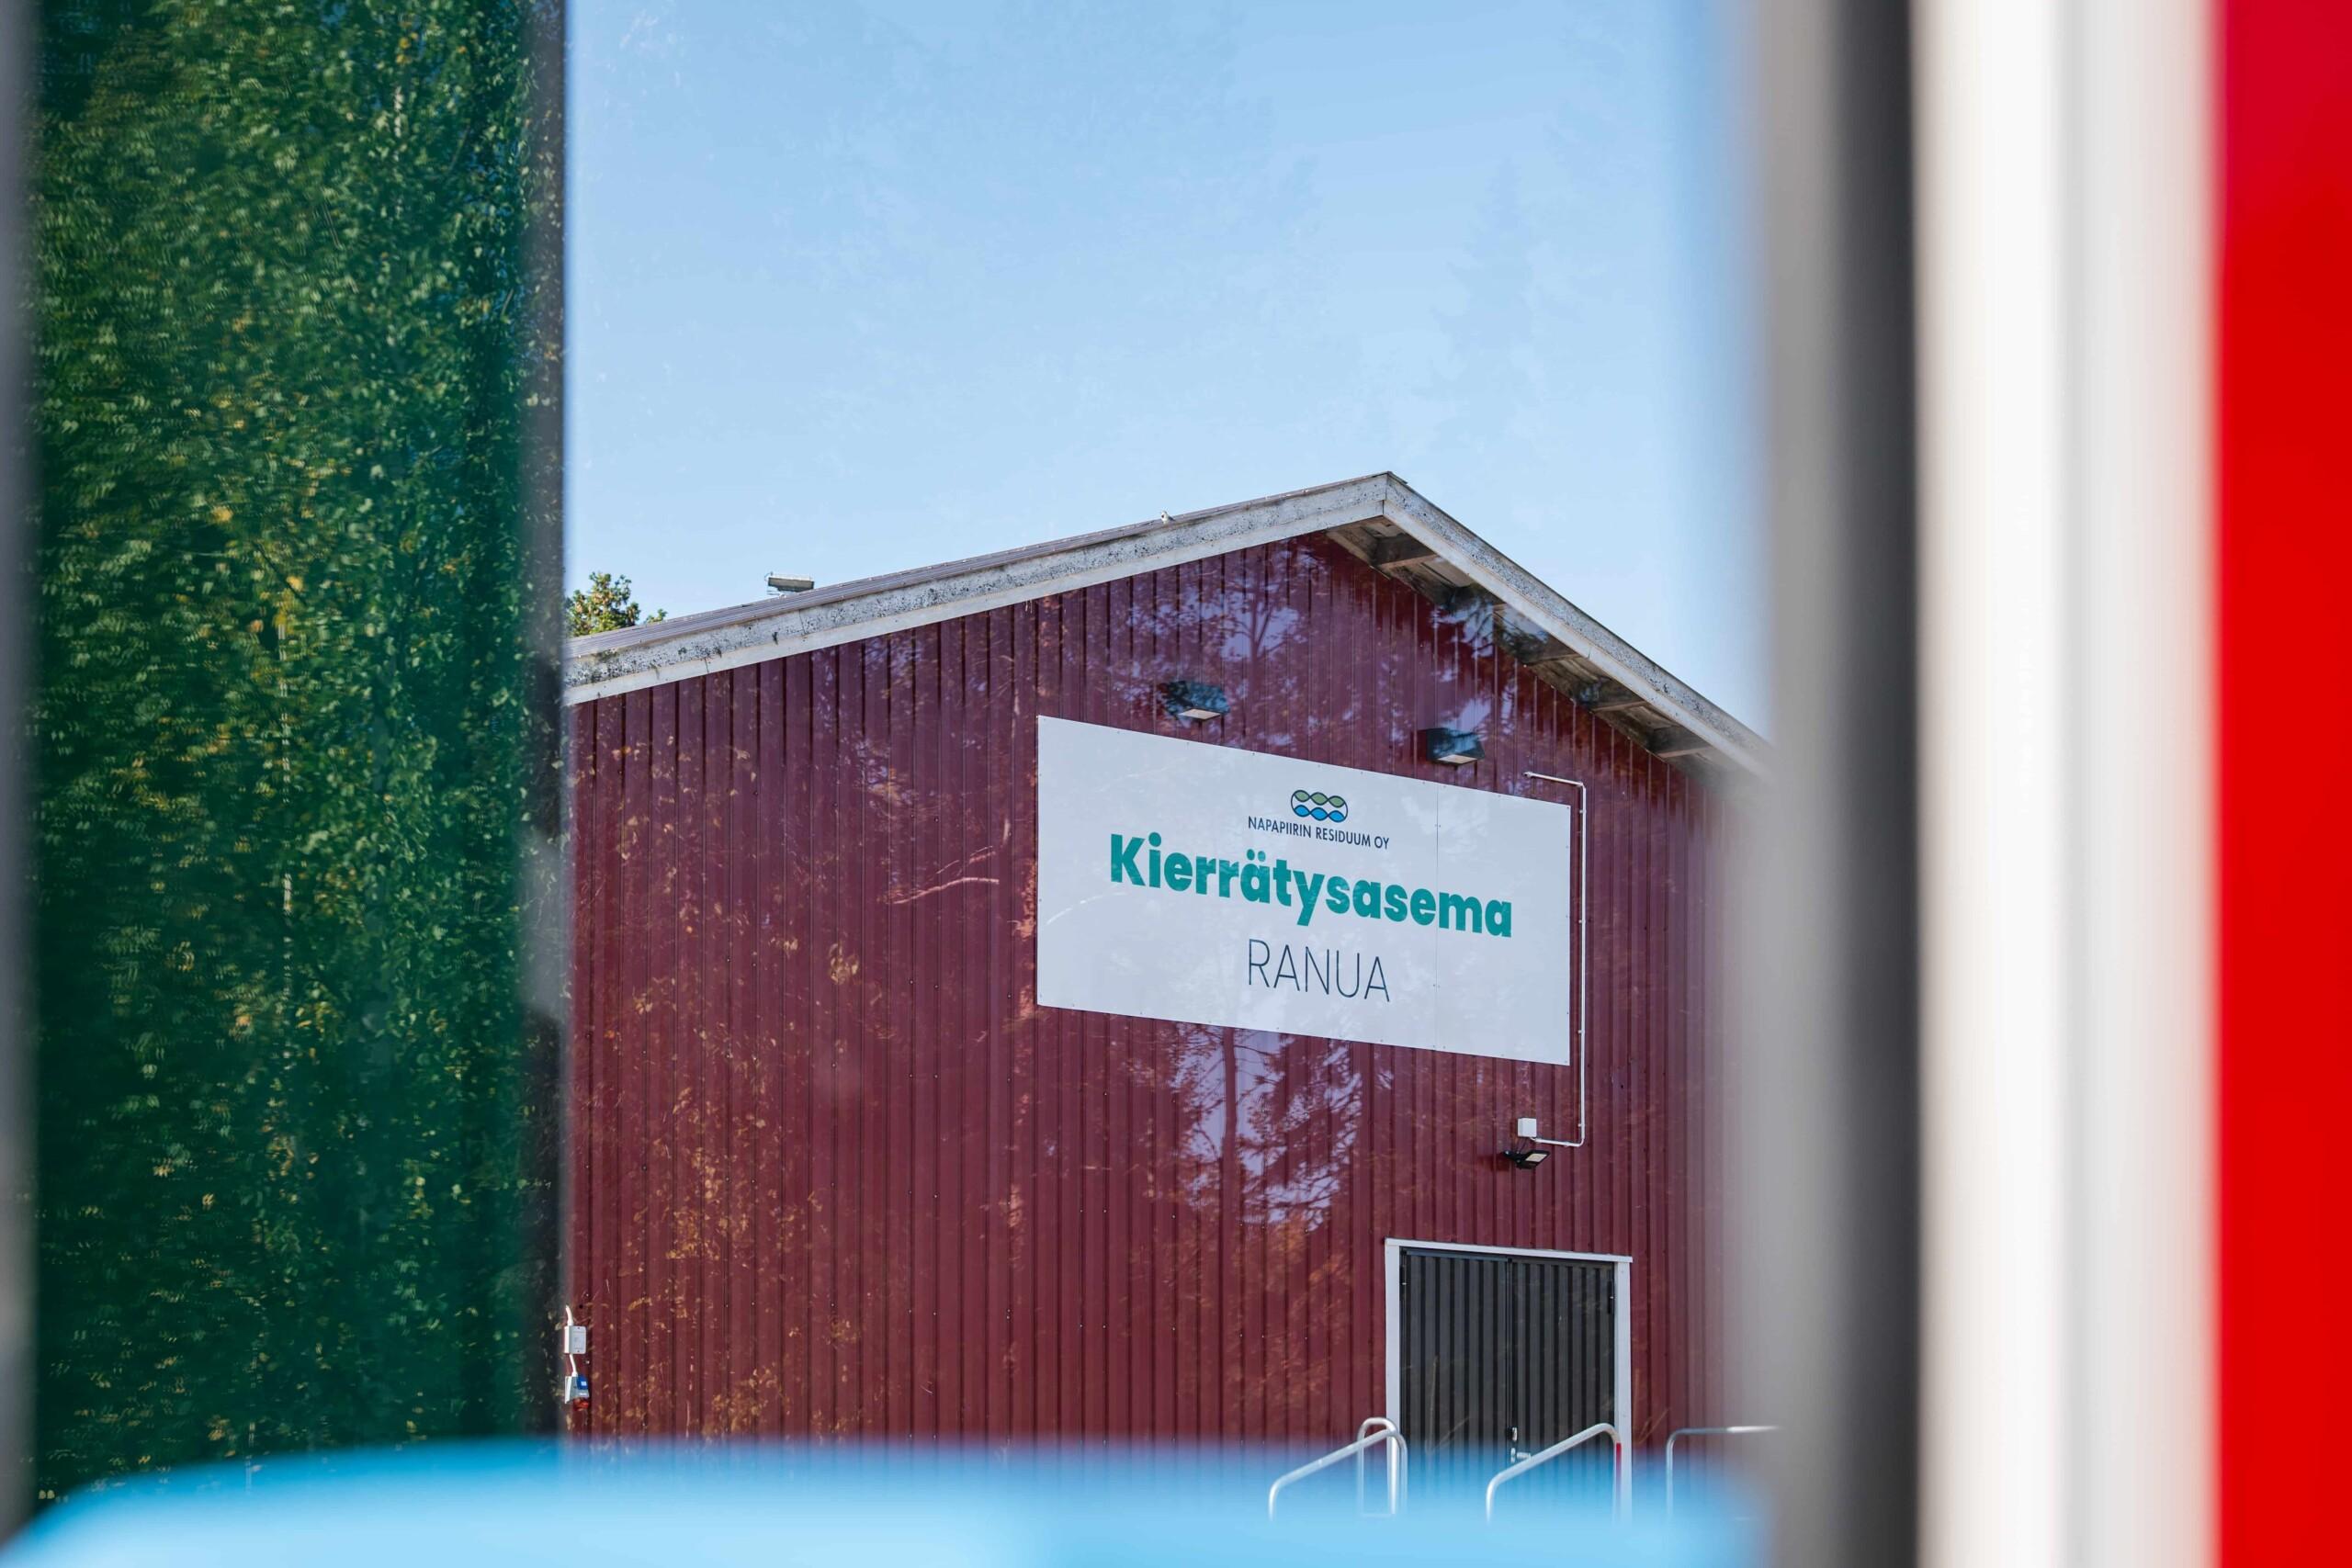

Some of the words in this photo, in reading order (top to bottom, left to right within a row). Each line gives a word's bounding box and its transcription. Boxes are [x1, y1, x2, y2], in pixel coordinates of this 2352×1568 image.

[1248, 815, 1312, 839] NAPAPIIRIN
[1316, 827, 1372, 848] RESIDUUM
[1374, 835, 1390, 850] OY
[1110, 831, 1512, 938] Kierrätysasema
[1248, 938, 1390, 1003] RANUA
